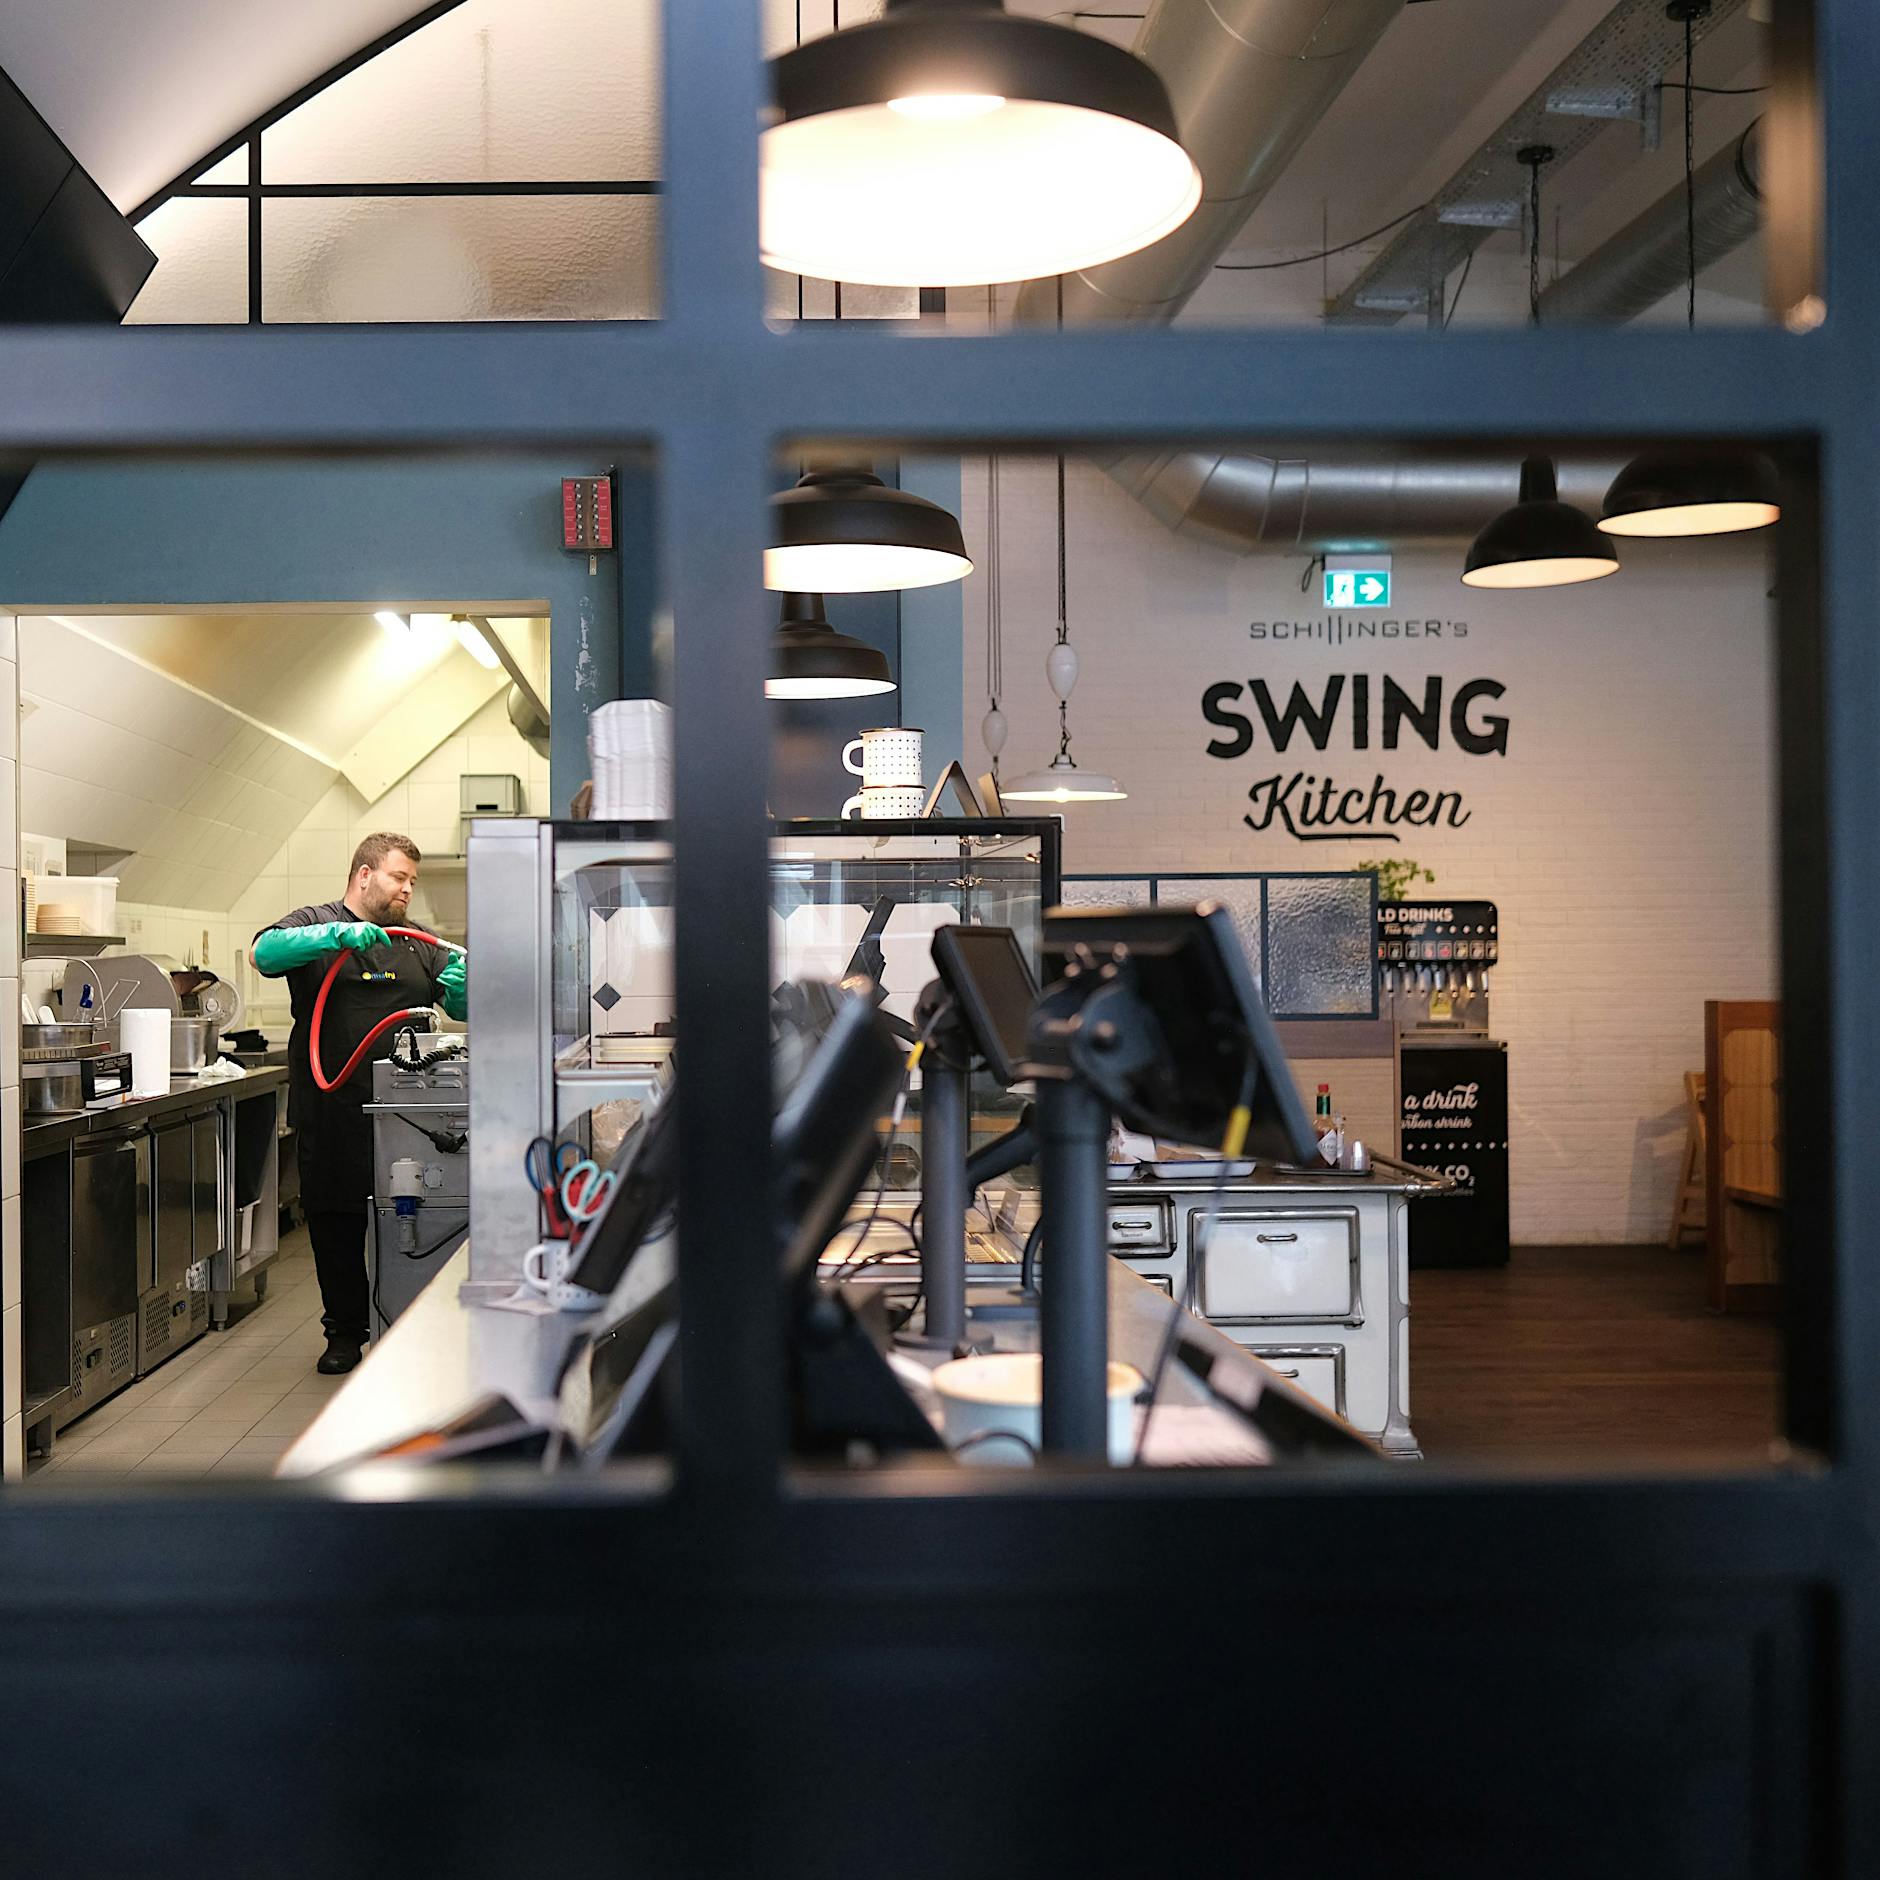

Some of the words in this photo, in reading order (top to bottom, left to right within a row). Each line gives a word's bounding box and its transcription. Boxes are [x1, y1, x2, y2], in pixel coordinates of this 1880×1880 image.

[1201, 674, 1510, 760] SWING
[1244, 772, 1472, 843] Kitchen
[1398, 907, 1455, 922] DRINKS
[1404, 1094, 1420, 1110] a
[1422, 1082, 1479, 1110] drink
[1434, 1115, 1472, 1129] shrink
